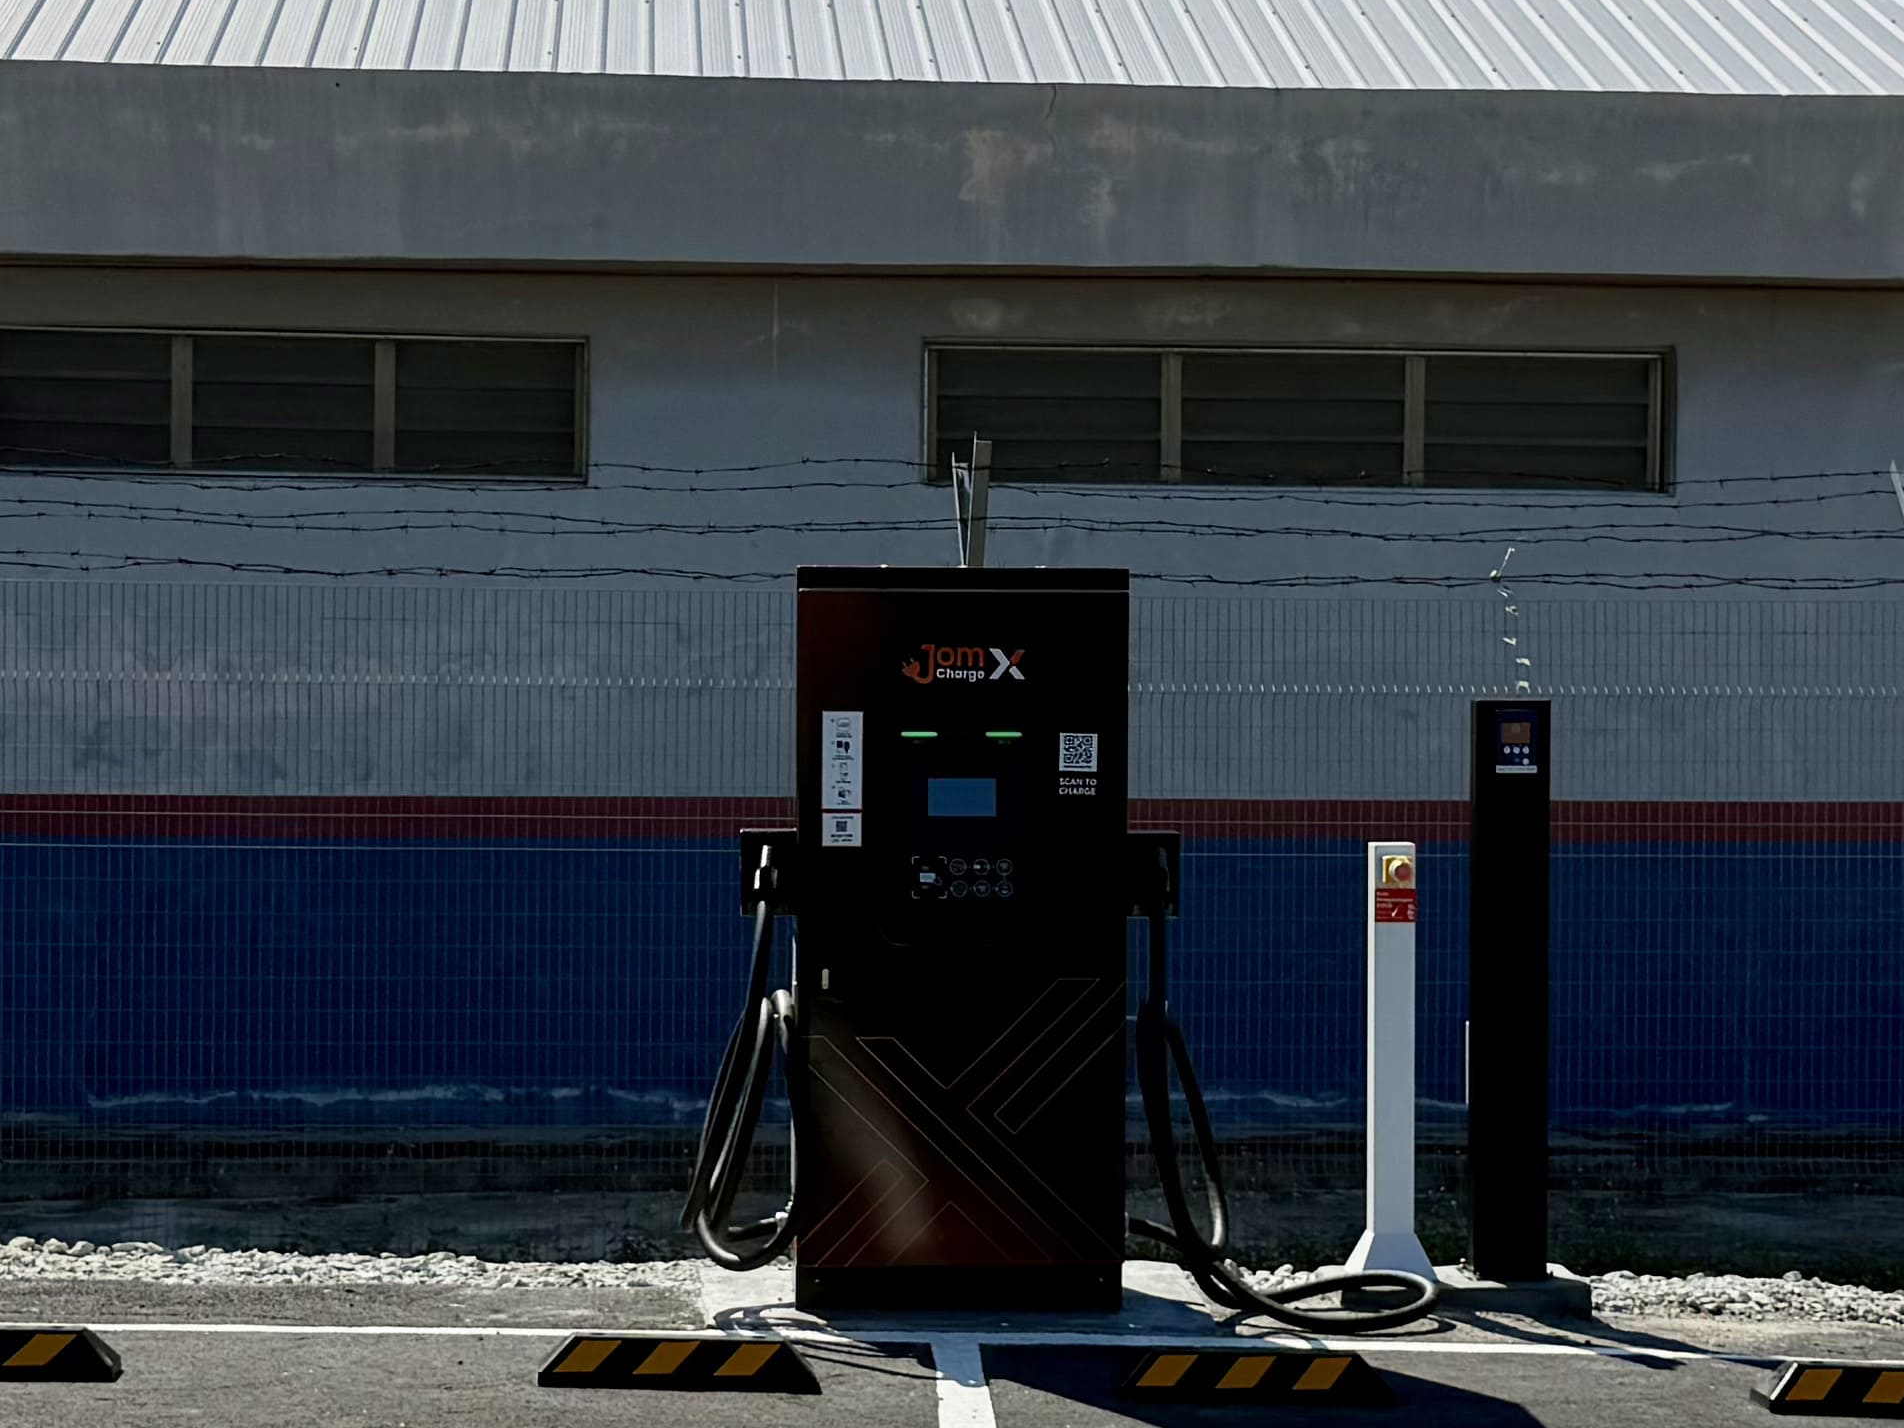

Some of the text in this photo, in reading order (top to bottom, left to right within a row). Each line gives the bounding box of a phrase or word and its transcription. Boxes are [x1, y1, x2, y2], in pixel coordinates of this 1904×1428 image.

[902, 644, 1026, 684] Jom X
[936, 668, 985, 682] Charge
[1059, 777, 1097, 786] SCAN TO
[1058, 787, 1097, 796] CHARGE
